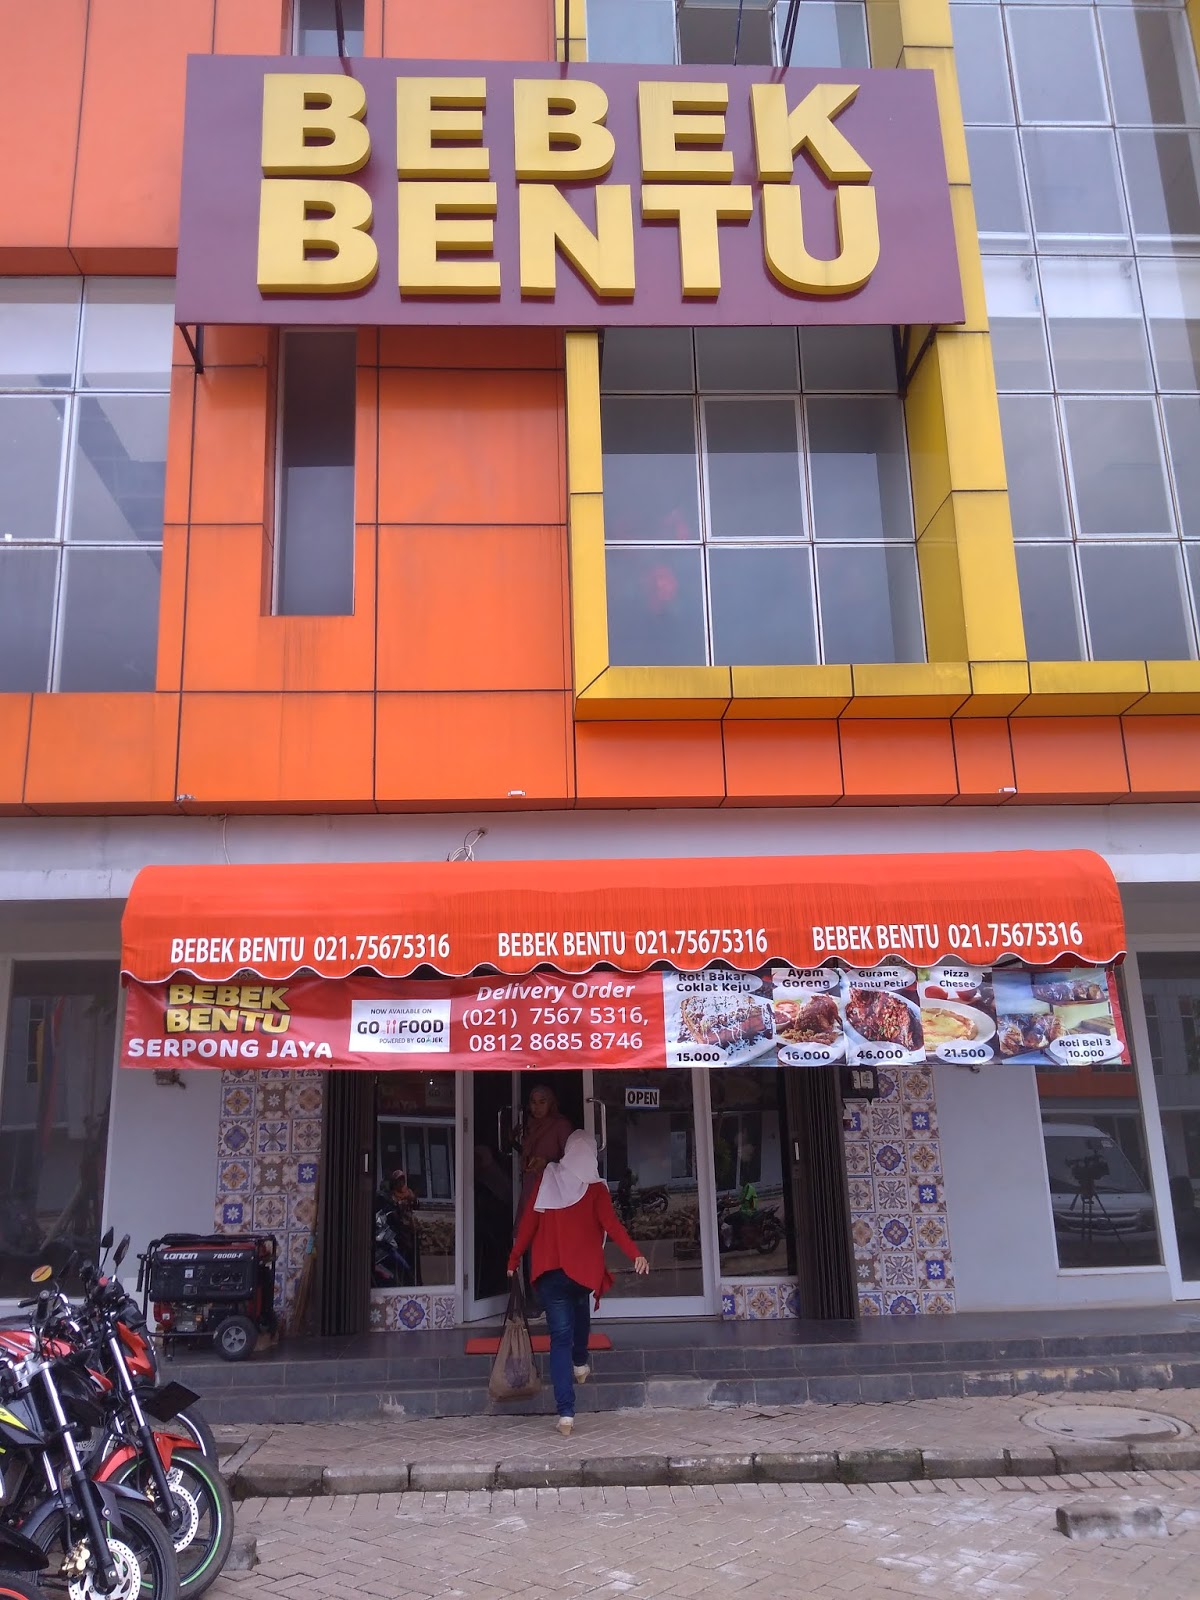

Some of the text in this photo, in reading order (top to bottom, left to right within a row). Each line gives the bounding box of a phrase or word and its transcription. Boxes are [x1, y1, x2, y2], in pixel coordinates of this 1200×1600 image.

[261, 73, 873, 182] BEBEK
[256, 179, 882, 298] BENTU
[812, 921, 1083, 951] BEBEK BENTU 021.75675316
[170, 933, 450, 964] BEBEK BENTU 021.75675316
[498, 928, 768, 957] BEBEK BENTU 021.75675316
[678, 971, 747, 982] Roti Bakar
[788, 968, 824, 980] Ayam
[858, 970, 898, 978] Gurame
[943, 970, 970, 978] Pizza
[676, 983, 751, 993] Coklat Keju
[782, 979, 830, 989] Goreng
[884, 980, 909, 988] Petir
[939, 980, 976, 988] Chesee
[167, 984, 290, 1011] BEBEK
[476, 982, 636, 1002] Delivery Order
[166, 1008, 290, 1033] BENTU
[462, 1006, 649, 1030] (021) 7567 5316,
[357, 1019, 444, 1034] GO FOOD
[469, 1032, 643, 1052] 0812 8685 8746
[1058, 1039, 1080, 1047] Roti
[1082, 1038, 1103, 1047] Beli
[127, 1038, 333, 1059] SERPONG JAYA
[856, 1049, 903, 1060] 46.000
[943, 1048, 986, 1059] 21.500
[1068, 1049, 1105, 1058] 10.000
[676, 1052, 720, 1062] 15.000
[785, 1050, 830, 1061] 16.000
[627, 1090, 658, 1105] OPEN
